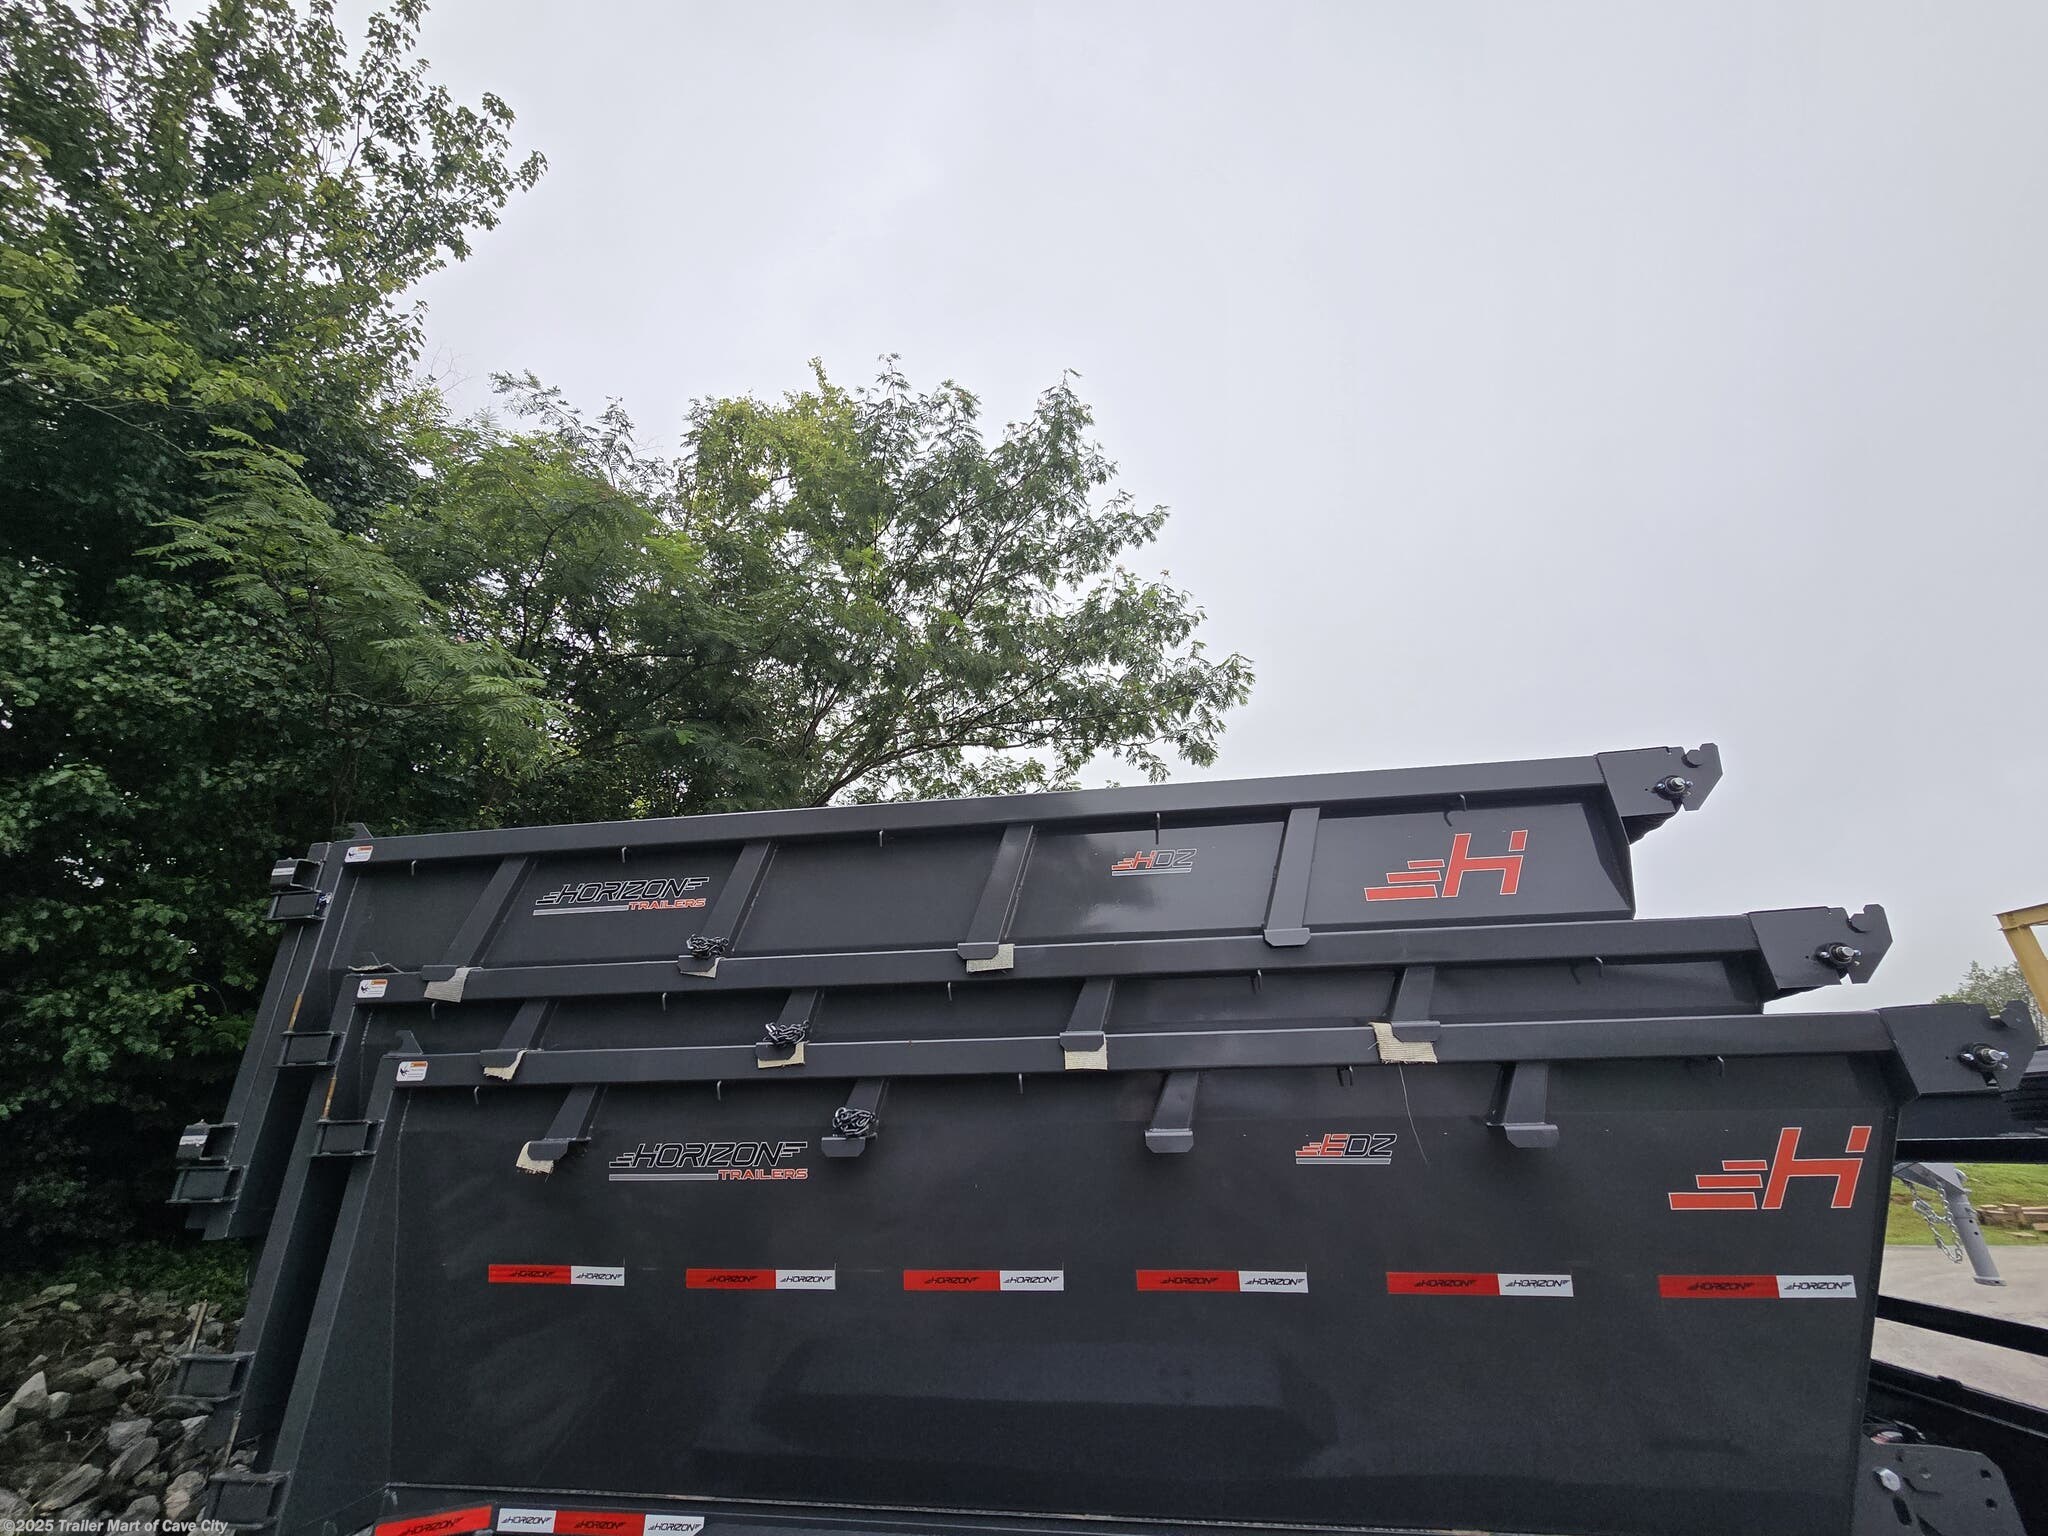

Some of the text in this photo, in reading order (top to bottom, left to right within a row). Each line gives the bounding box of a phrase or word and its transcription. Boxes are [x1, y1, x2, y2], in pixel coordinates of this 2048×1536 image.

[555, 877, 692, 904] HORIZON
[629, 898, 706, 910] TRAILERS
[632, 1142, 788, 1168] HORIZON
[718, 1168, 808, 1180] TRAILERS
[512, 1270, 555, 1279] HORIZON
[577, 1272, 622, 1280] HORIZON
[708, 1275, 757, 1284] HORIZON
[1004, 1276, 1058, 1284] HORIZON
[1161, 1277, 1217, 1285] HORIZON
[1245, 1278, 1305, 1286] HORIZON
[1414, 1279, 1476, 1287] HORIZON
[1505, 1279, 1571, 1288] HORIZON
[1687, 1281, 1754, 1291] HORIZON
[1784, 1281, 1851, 1290] HORIZON
[502, 1516, 552, 1524] HORIZON
[401, 1518, 462, 1536] HORIZON
[574, 1521, 626, 1530] HORIZON
[648, 1523, 701, 1531] HORIZON
